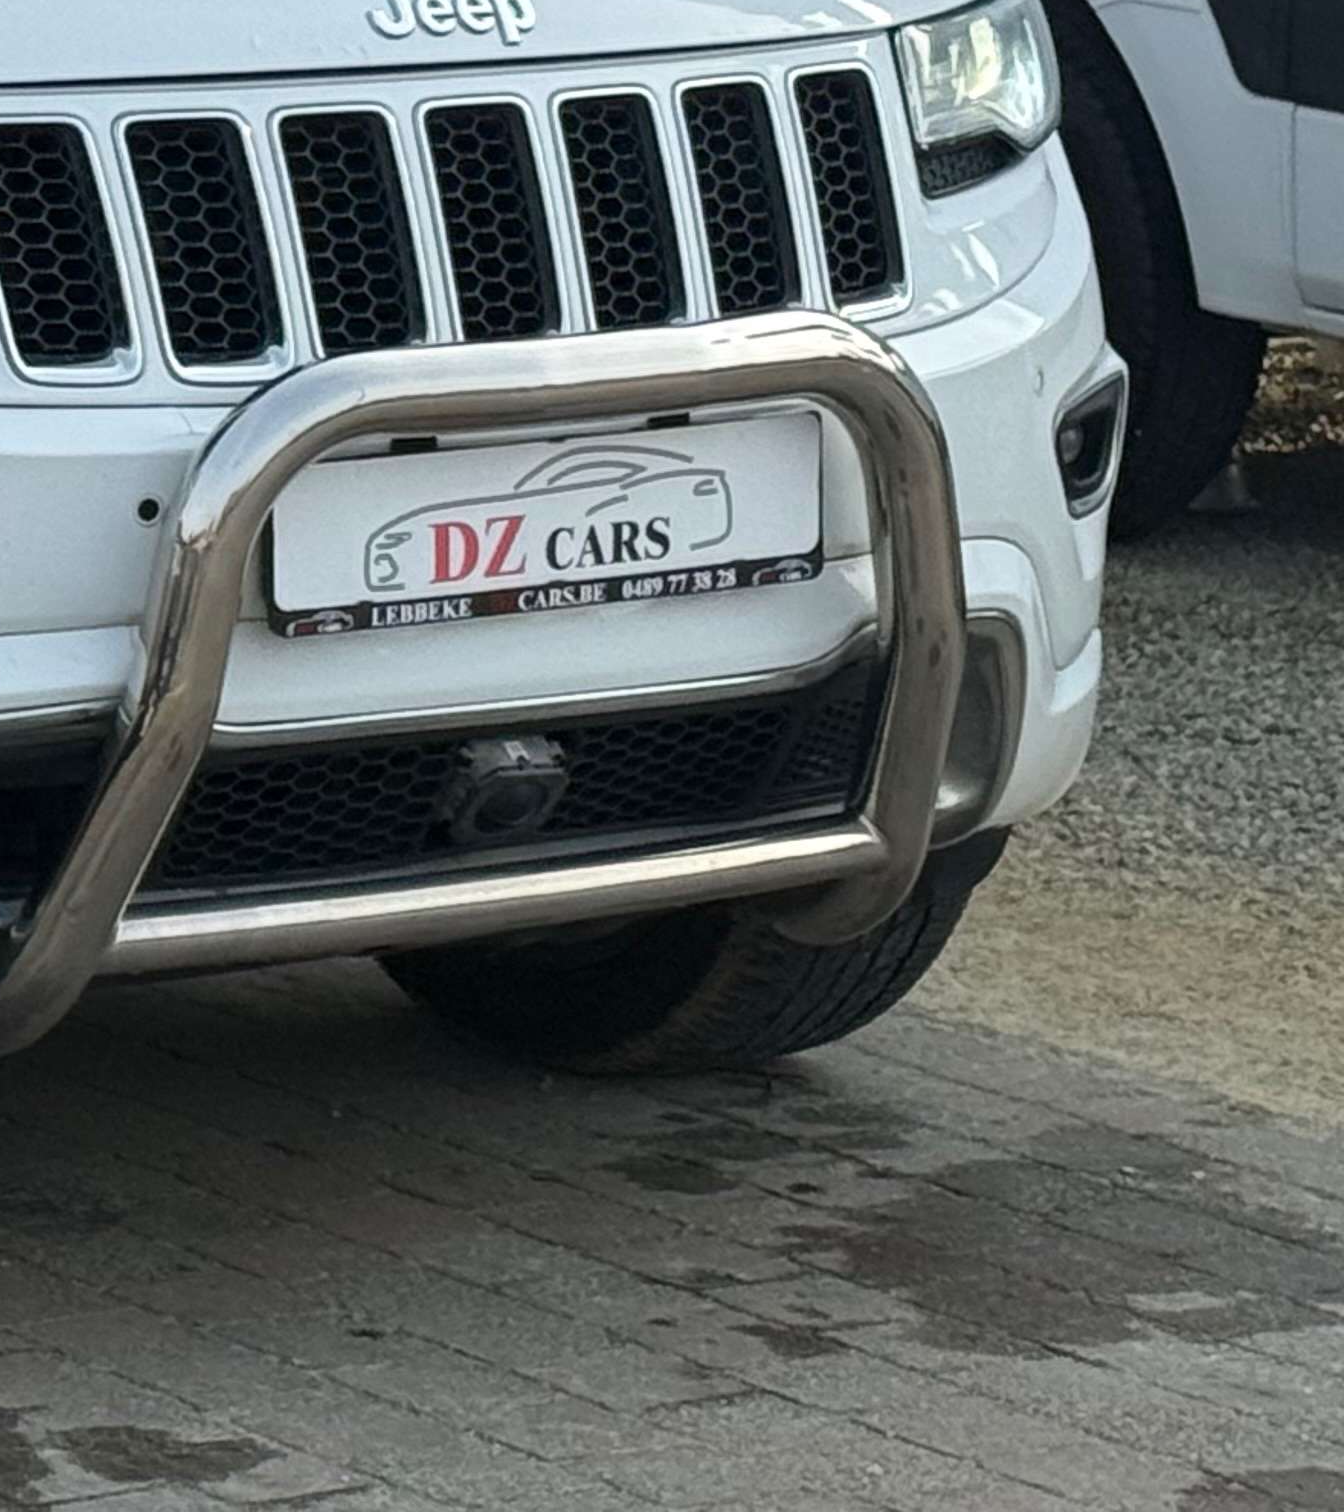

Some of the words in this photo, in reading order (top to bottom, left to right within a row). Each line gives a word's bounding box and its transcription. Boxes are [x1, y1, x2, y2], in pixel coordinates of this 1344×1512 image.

[428, 514, 526, 584] DZ
[545, 516, 671, 571] CARS
[371, 597, 473, 627] LEBBEKE
[622, 576, 664, 599] 0489
[667, 573, 689, 594] 77
